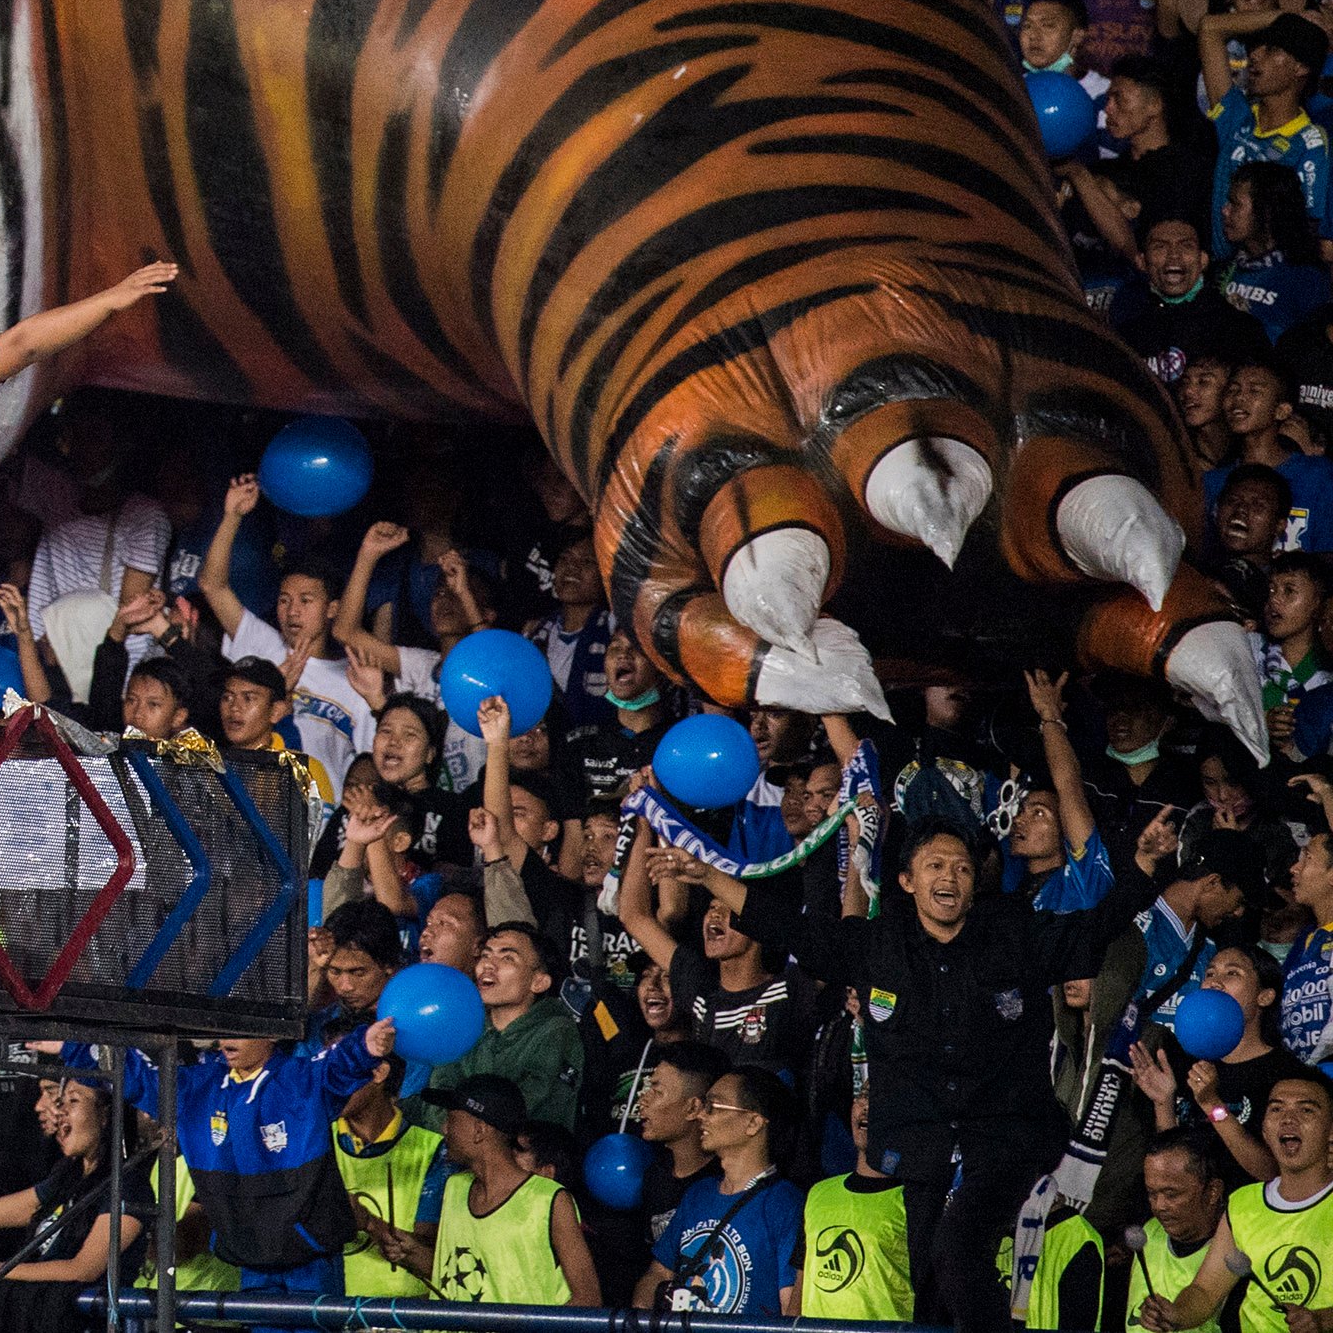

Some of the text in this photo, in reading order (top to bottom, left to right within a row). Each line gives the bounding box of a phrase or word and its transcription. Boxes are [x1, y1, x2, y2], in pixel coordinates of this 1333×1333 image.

[696, 1219, 732, 1233] FATHR
[737, 1243, 754, 1272] SON
[817, 1270, 844, 1282] adidas
